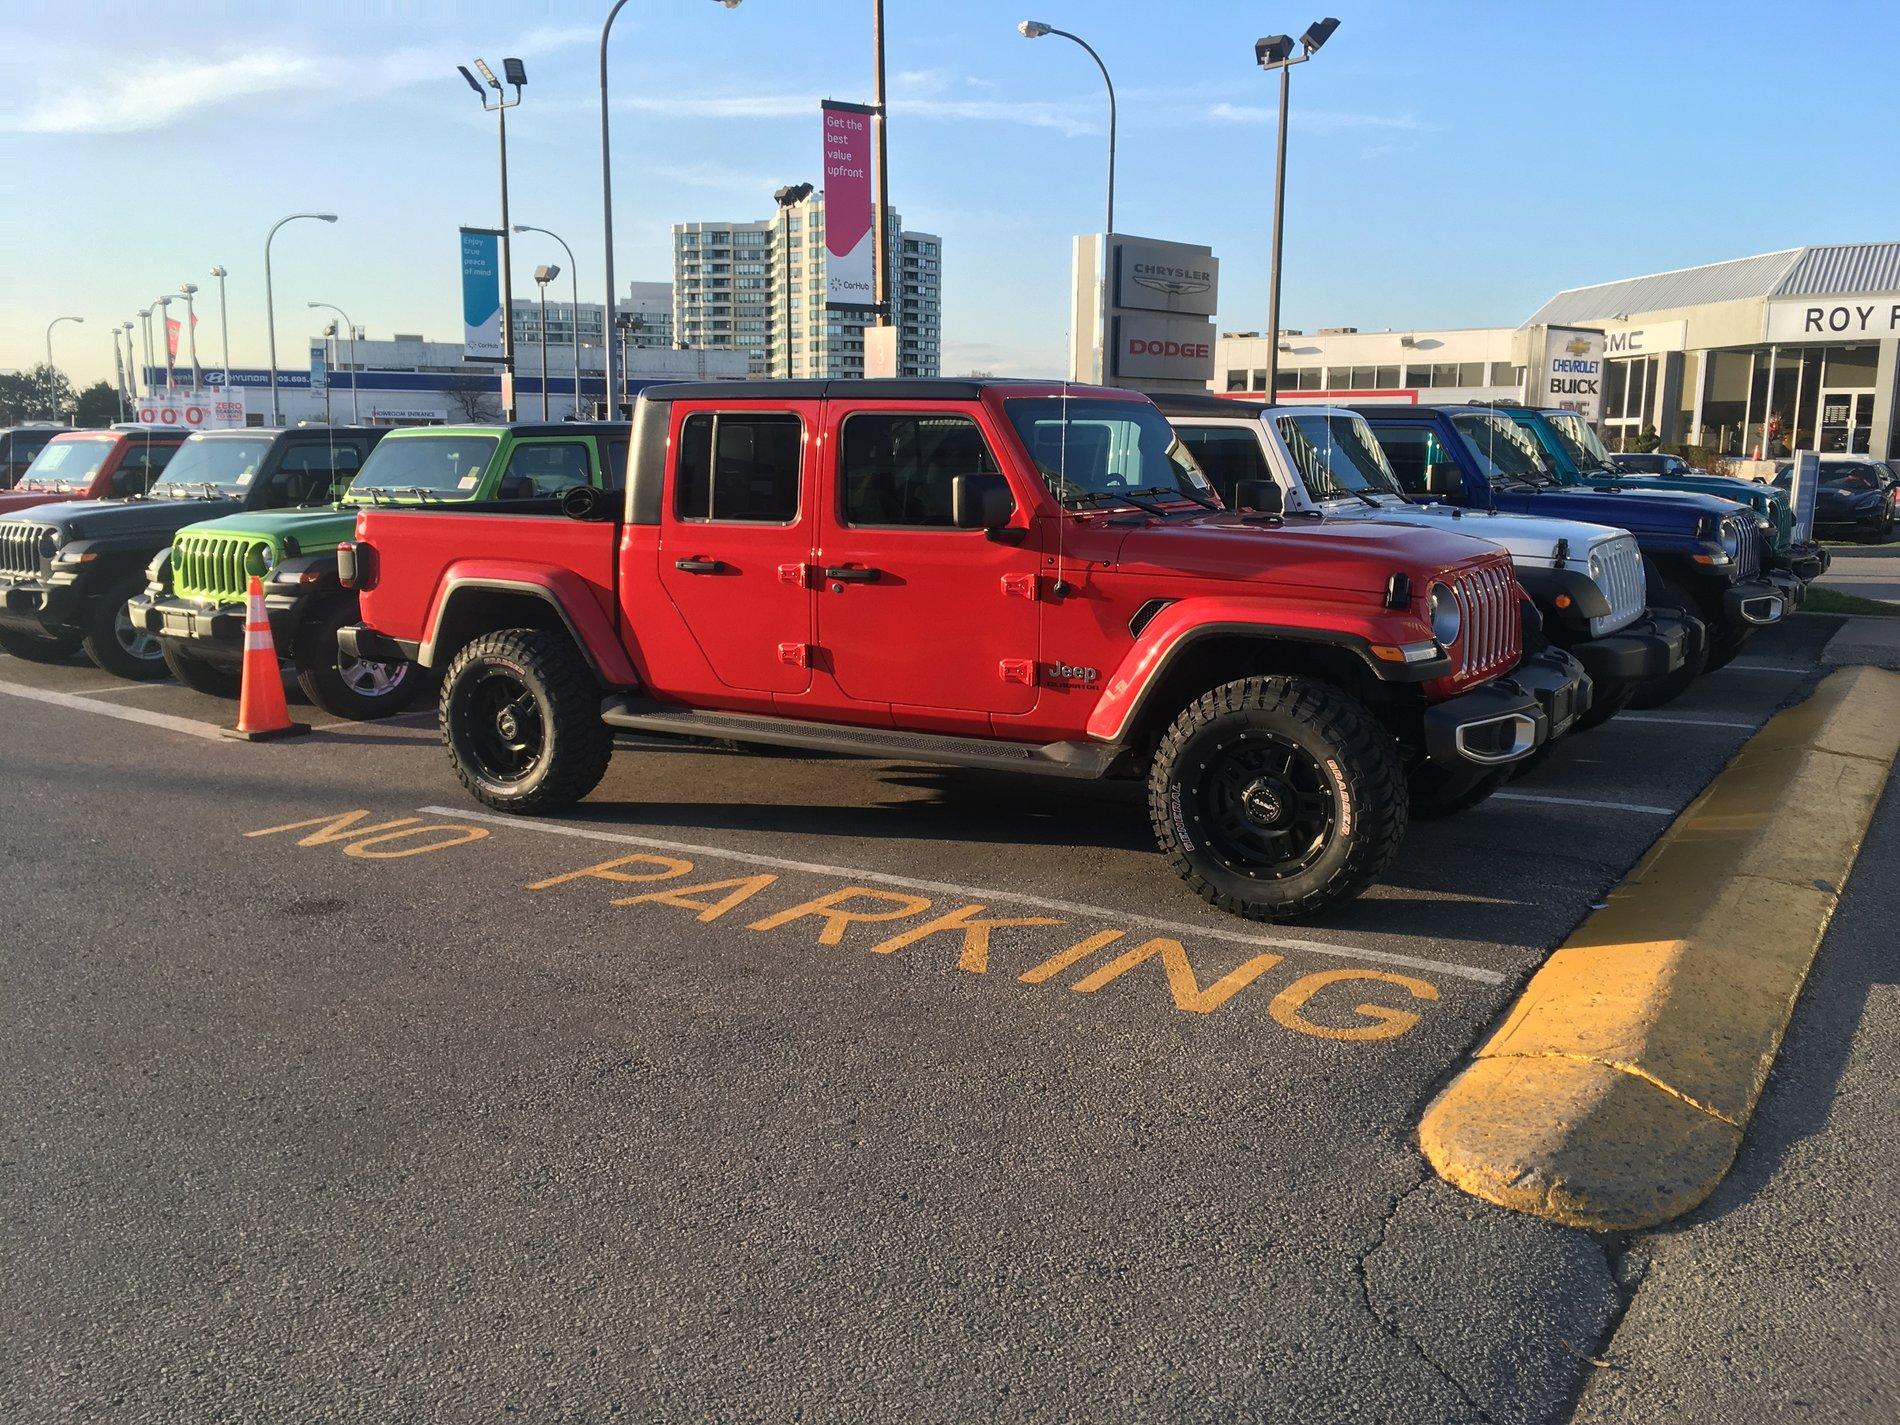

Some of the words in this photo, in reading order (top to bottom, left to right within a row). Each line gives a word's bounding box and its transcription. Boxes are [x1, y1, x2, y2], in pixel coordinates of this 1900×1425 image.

[827, 116, 845, 129] Get
[847, 119, 863, 131] the
[827, 133, 848, 145] best
[827, 150, 852, 161] value
[827, 166, 864, 178] upfront
[464, 237, 484, 246] Enjoy
[464, 258, 486, 266] peace
[474, 268, 491, 276] mind
[1134, 263, 1210, 281] CHRYSLER
[843, 281, 870, 290] CarHub
[1805, 306, 1875, 332] ROY
[1129, 338, 1209, 358] DODGE
[1553, 358, 1600, 374] CHEVROLET
[1550, 378, 1599, 395] BUICK
[215, 402, 243, 410] ZERO
[1049, 660, 1096, 683] Jeep
[1327, 759, 1352, 836] GRABBER
[1172, 782, 1196, 852] GENERAL
[242, 809, 490, 859] NO
[525, 853, 1440, 1040] PARKING
